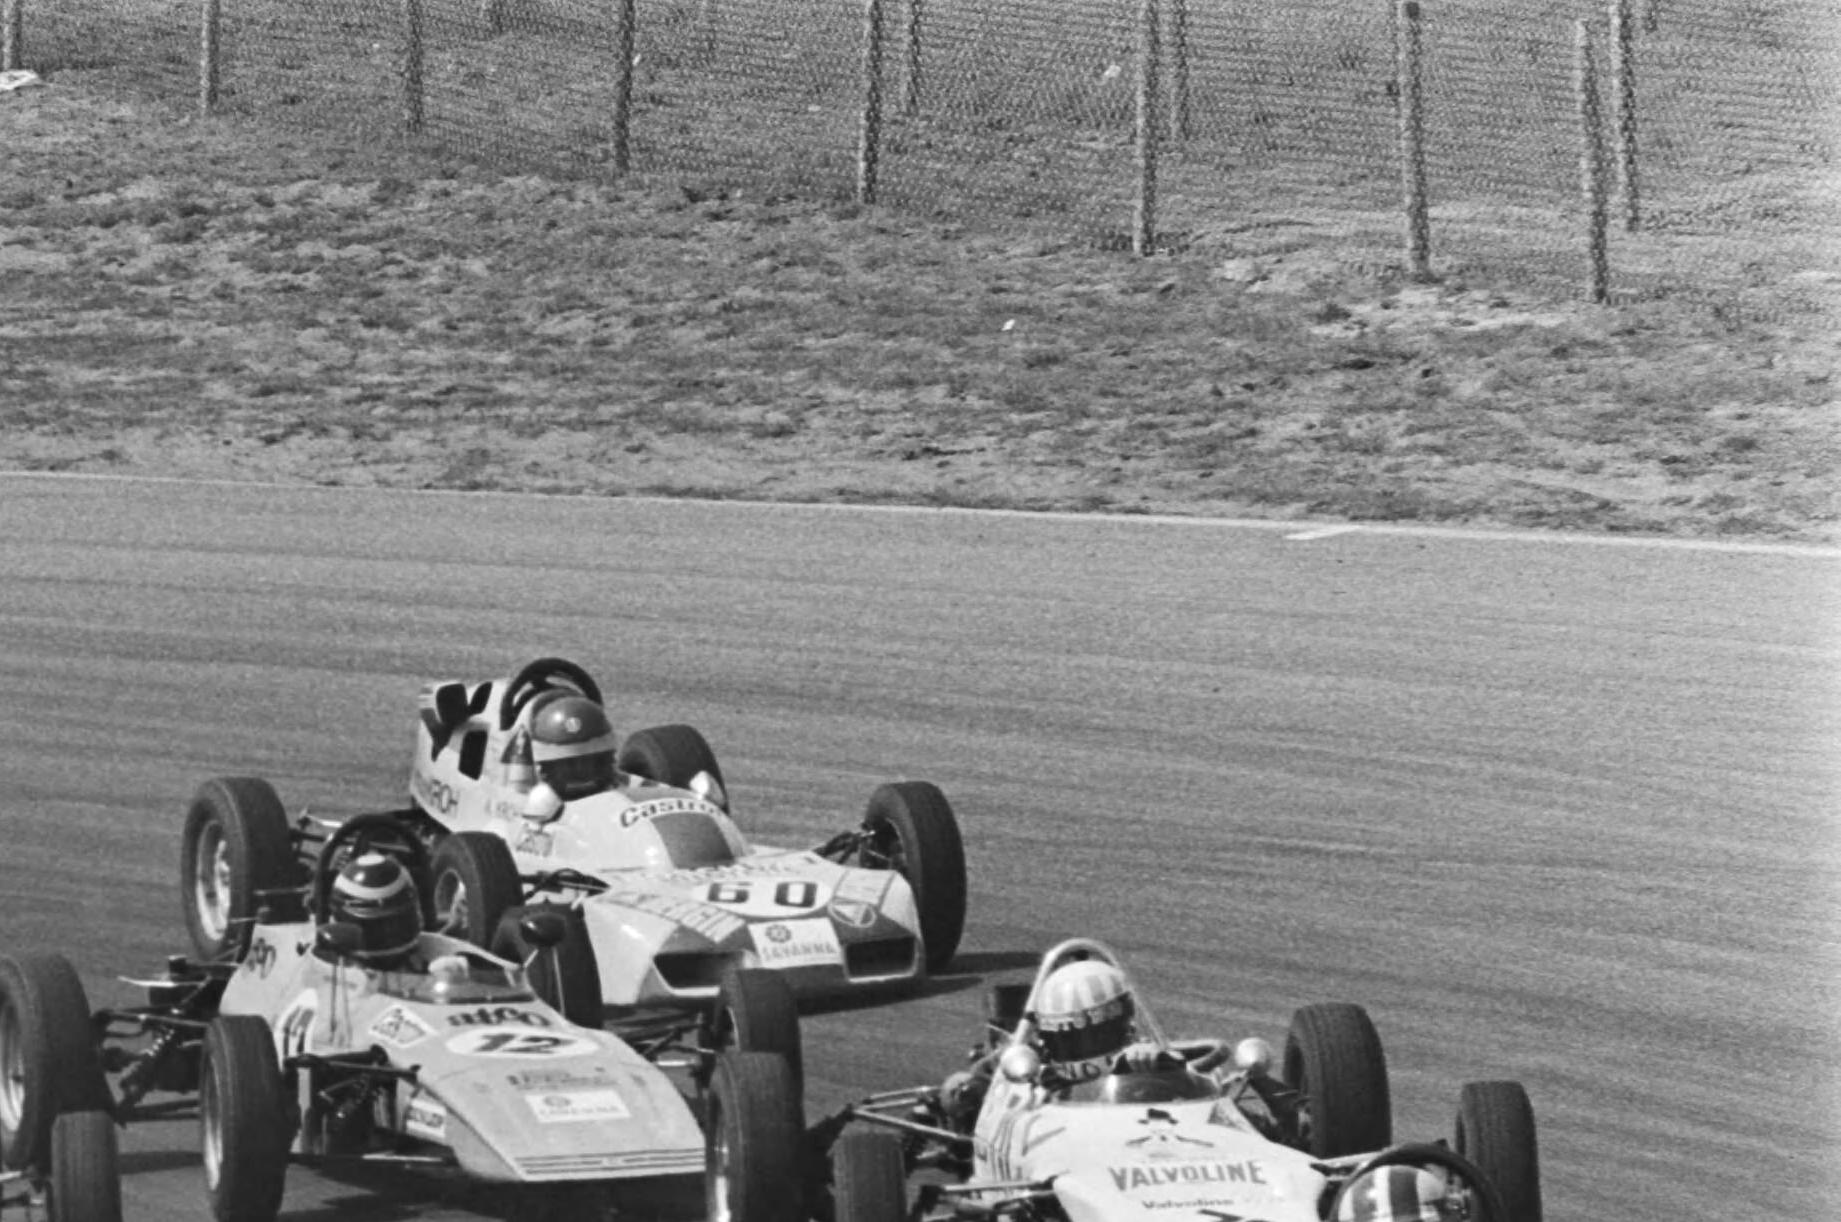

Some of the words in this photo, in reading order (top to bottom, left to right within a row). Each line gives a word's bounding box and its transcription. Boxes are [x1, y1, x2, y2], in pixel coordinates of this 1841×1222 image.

[707, 880, 819, 909] 60
[761, 941, 839, 962] SAVANNA
[472, 1032, 573, 1055] 12
[1108, 1159, 1268, 1193] VALVOLINE
[1141, 1198, 1235, 1210] Valvoline
